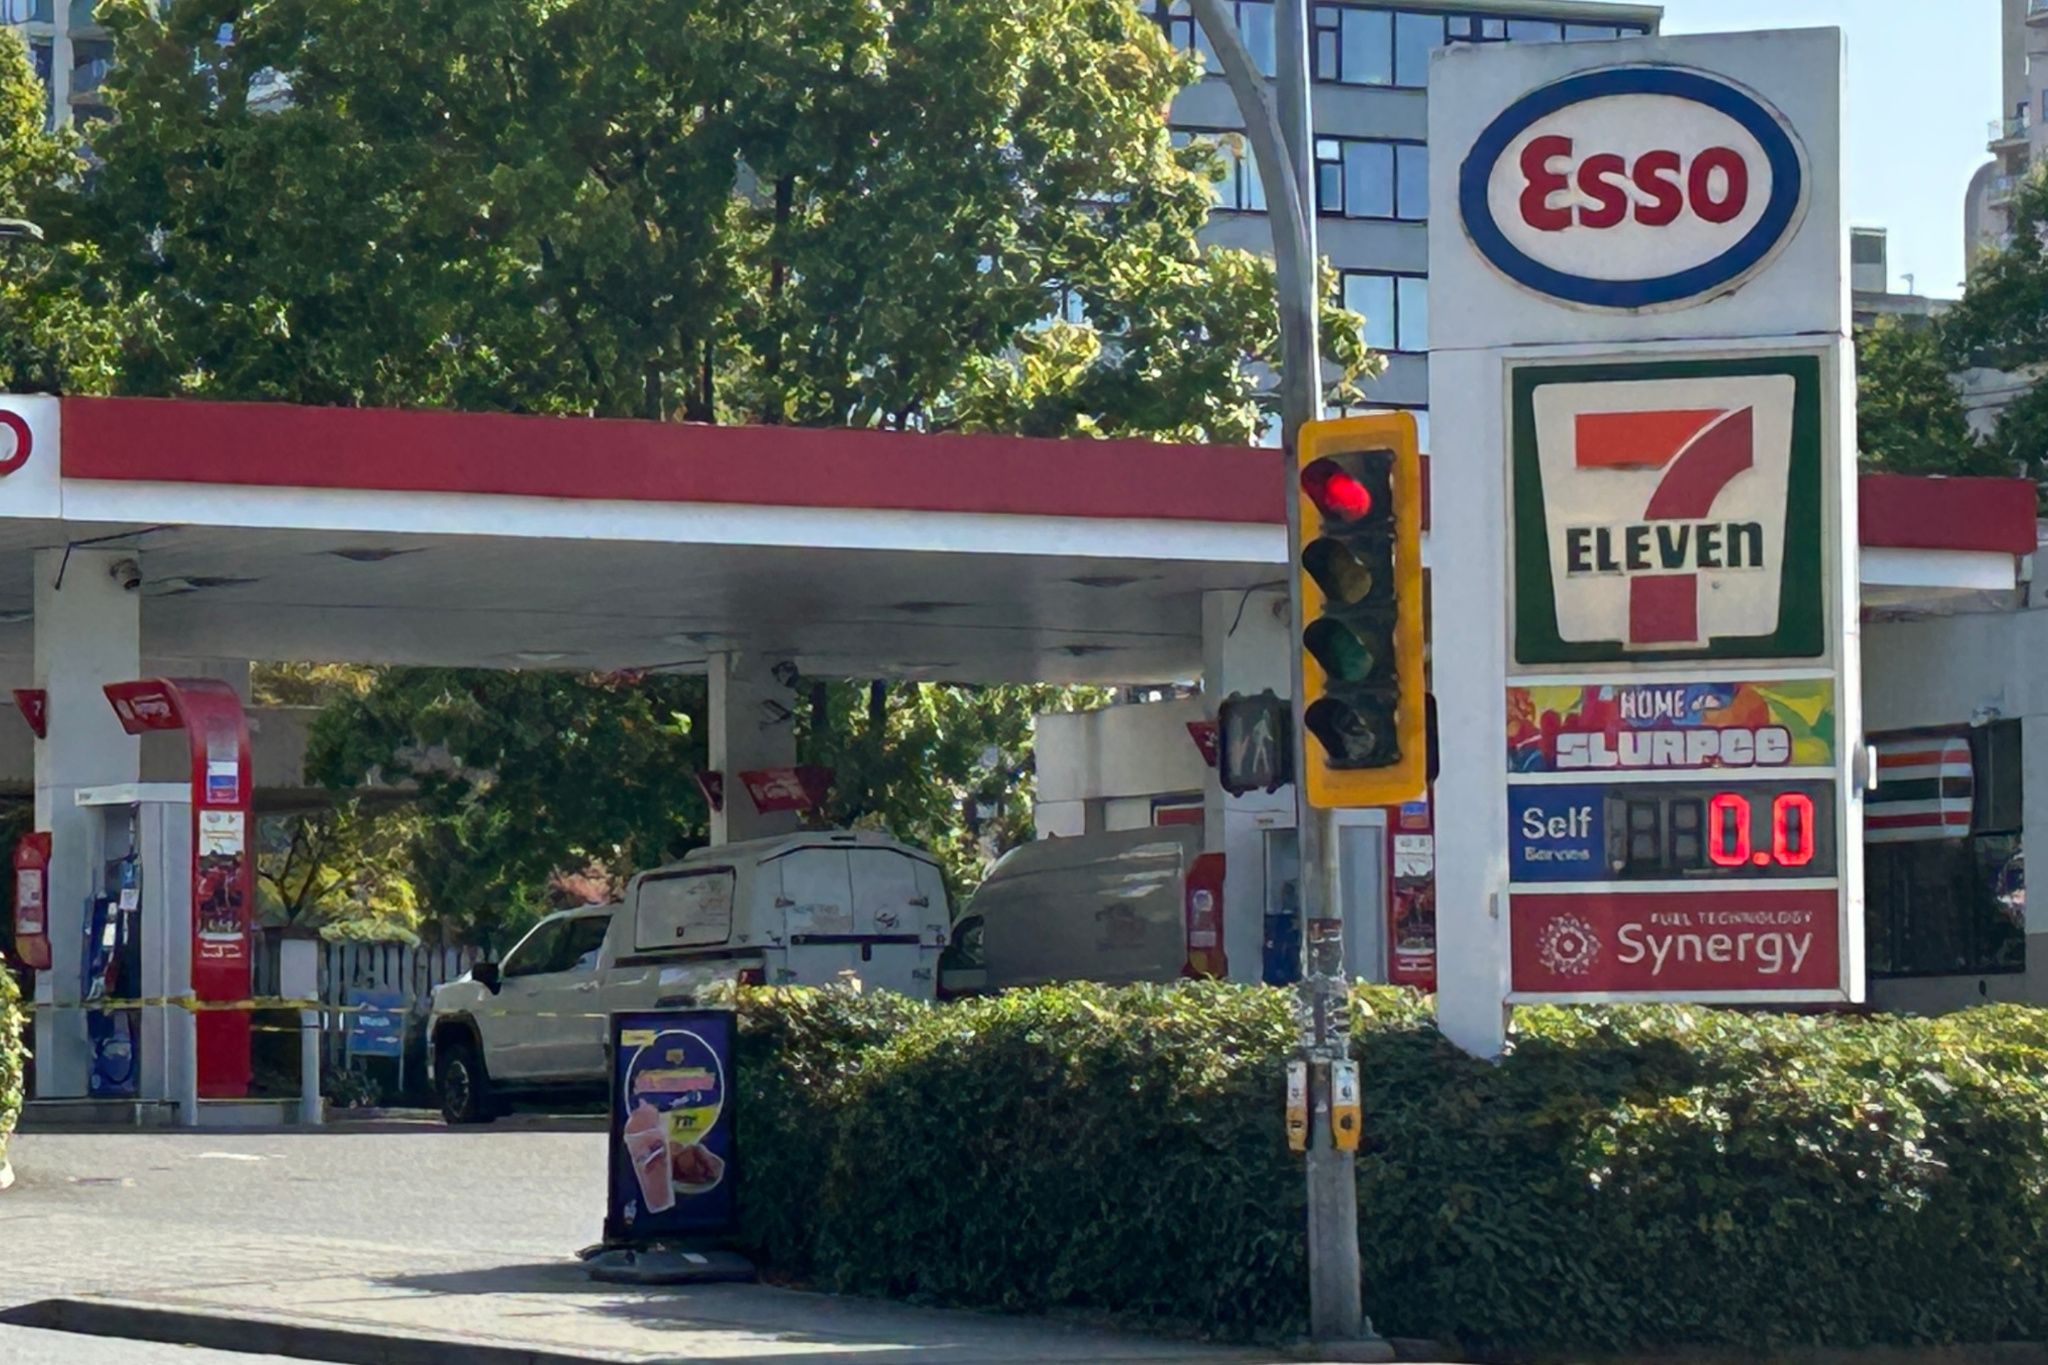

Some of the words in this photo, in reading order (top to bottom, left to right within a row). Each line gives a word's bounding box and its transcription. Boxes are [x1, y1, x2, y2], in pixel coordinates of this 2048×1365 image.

[1575, 405, 1754, 644] 7
[1619, 689, 1686, 720] HOME
[1522, 806, 1592, 839] Self
[1708, 793, 1814, 866] 0.0
[1698, 911, 1812, 925] TECHNOLOGY
[1617, 923, 1813, 976] Synergy
